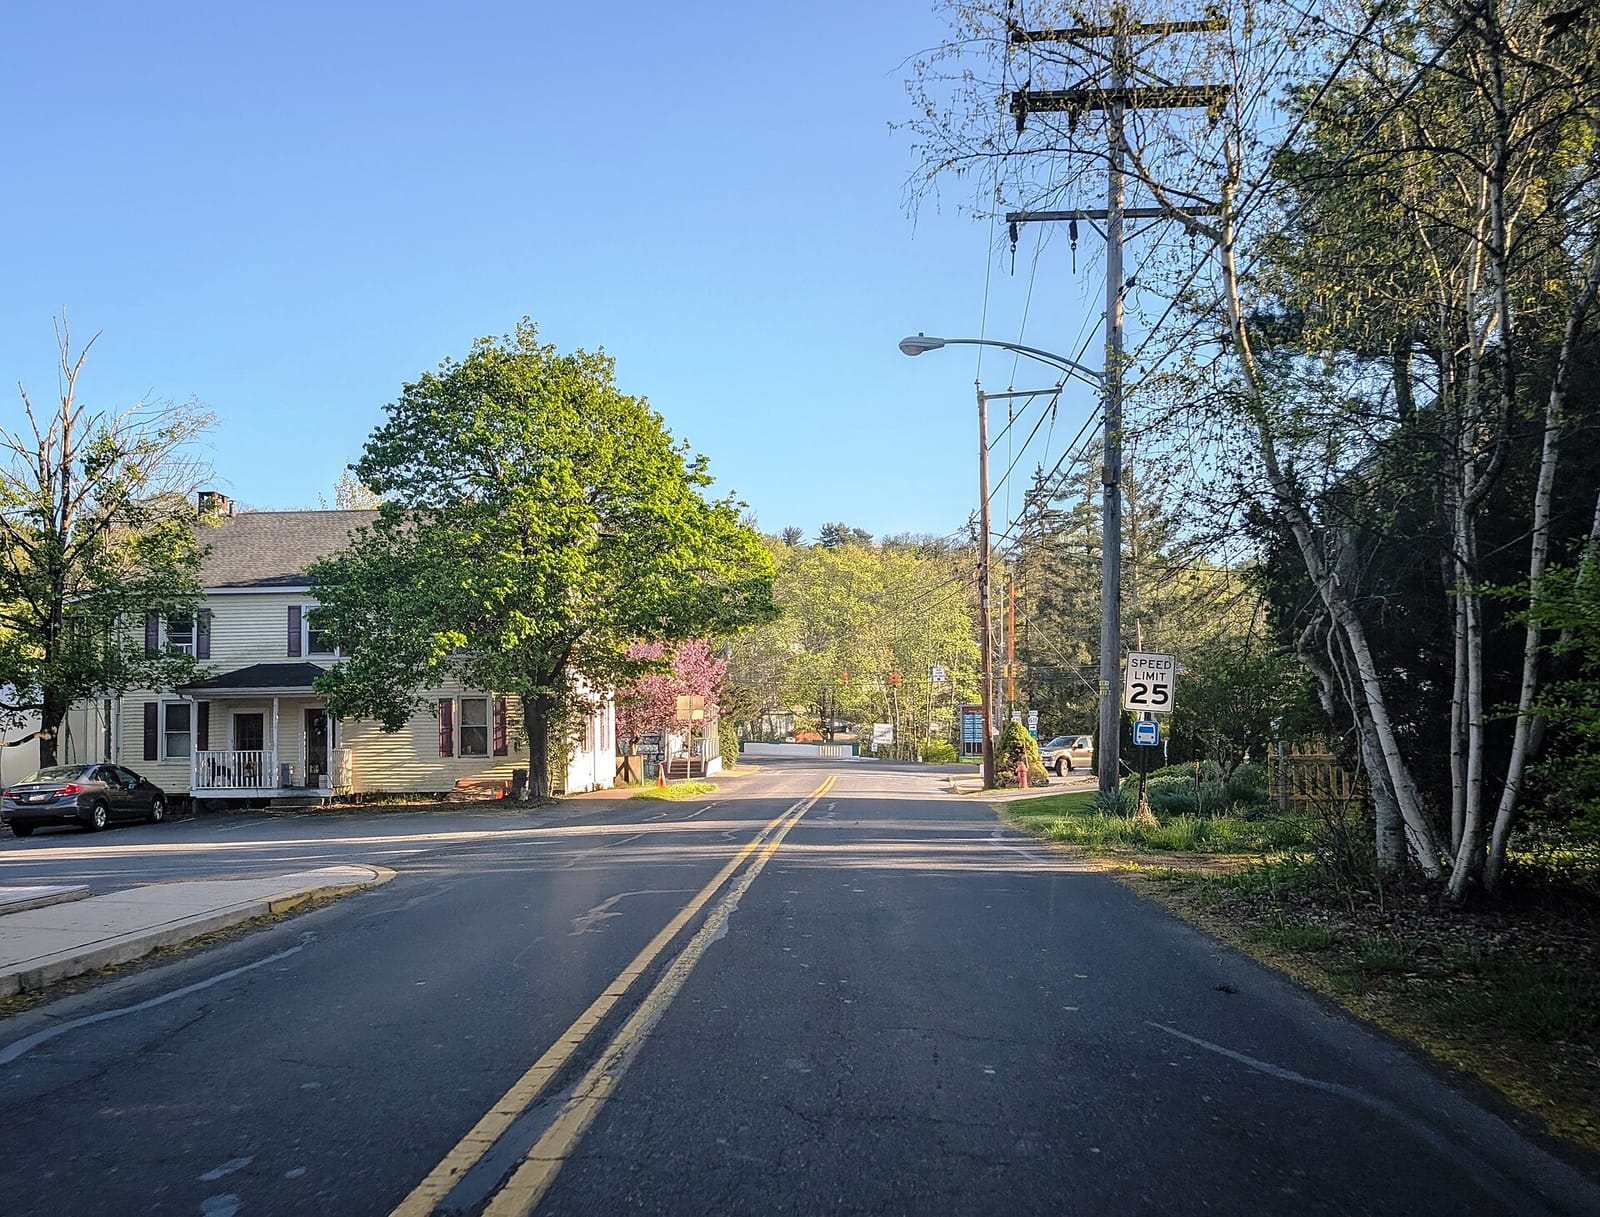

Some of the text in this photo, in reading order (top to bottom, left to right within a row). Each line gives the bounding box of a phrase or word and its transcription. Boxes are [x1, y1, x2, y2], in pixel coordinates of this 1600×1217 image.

[1131, 658, 1172, 670] SPEED
[1134, 671, 1167, 681] LIMIT
[1130, 683, 1168, 705] 25
